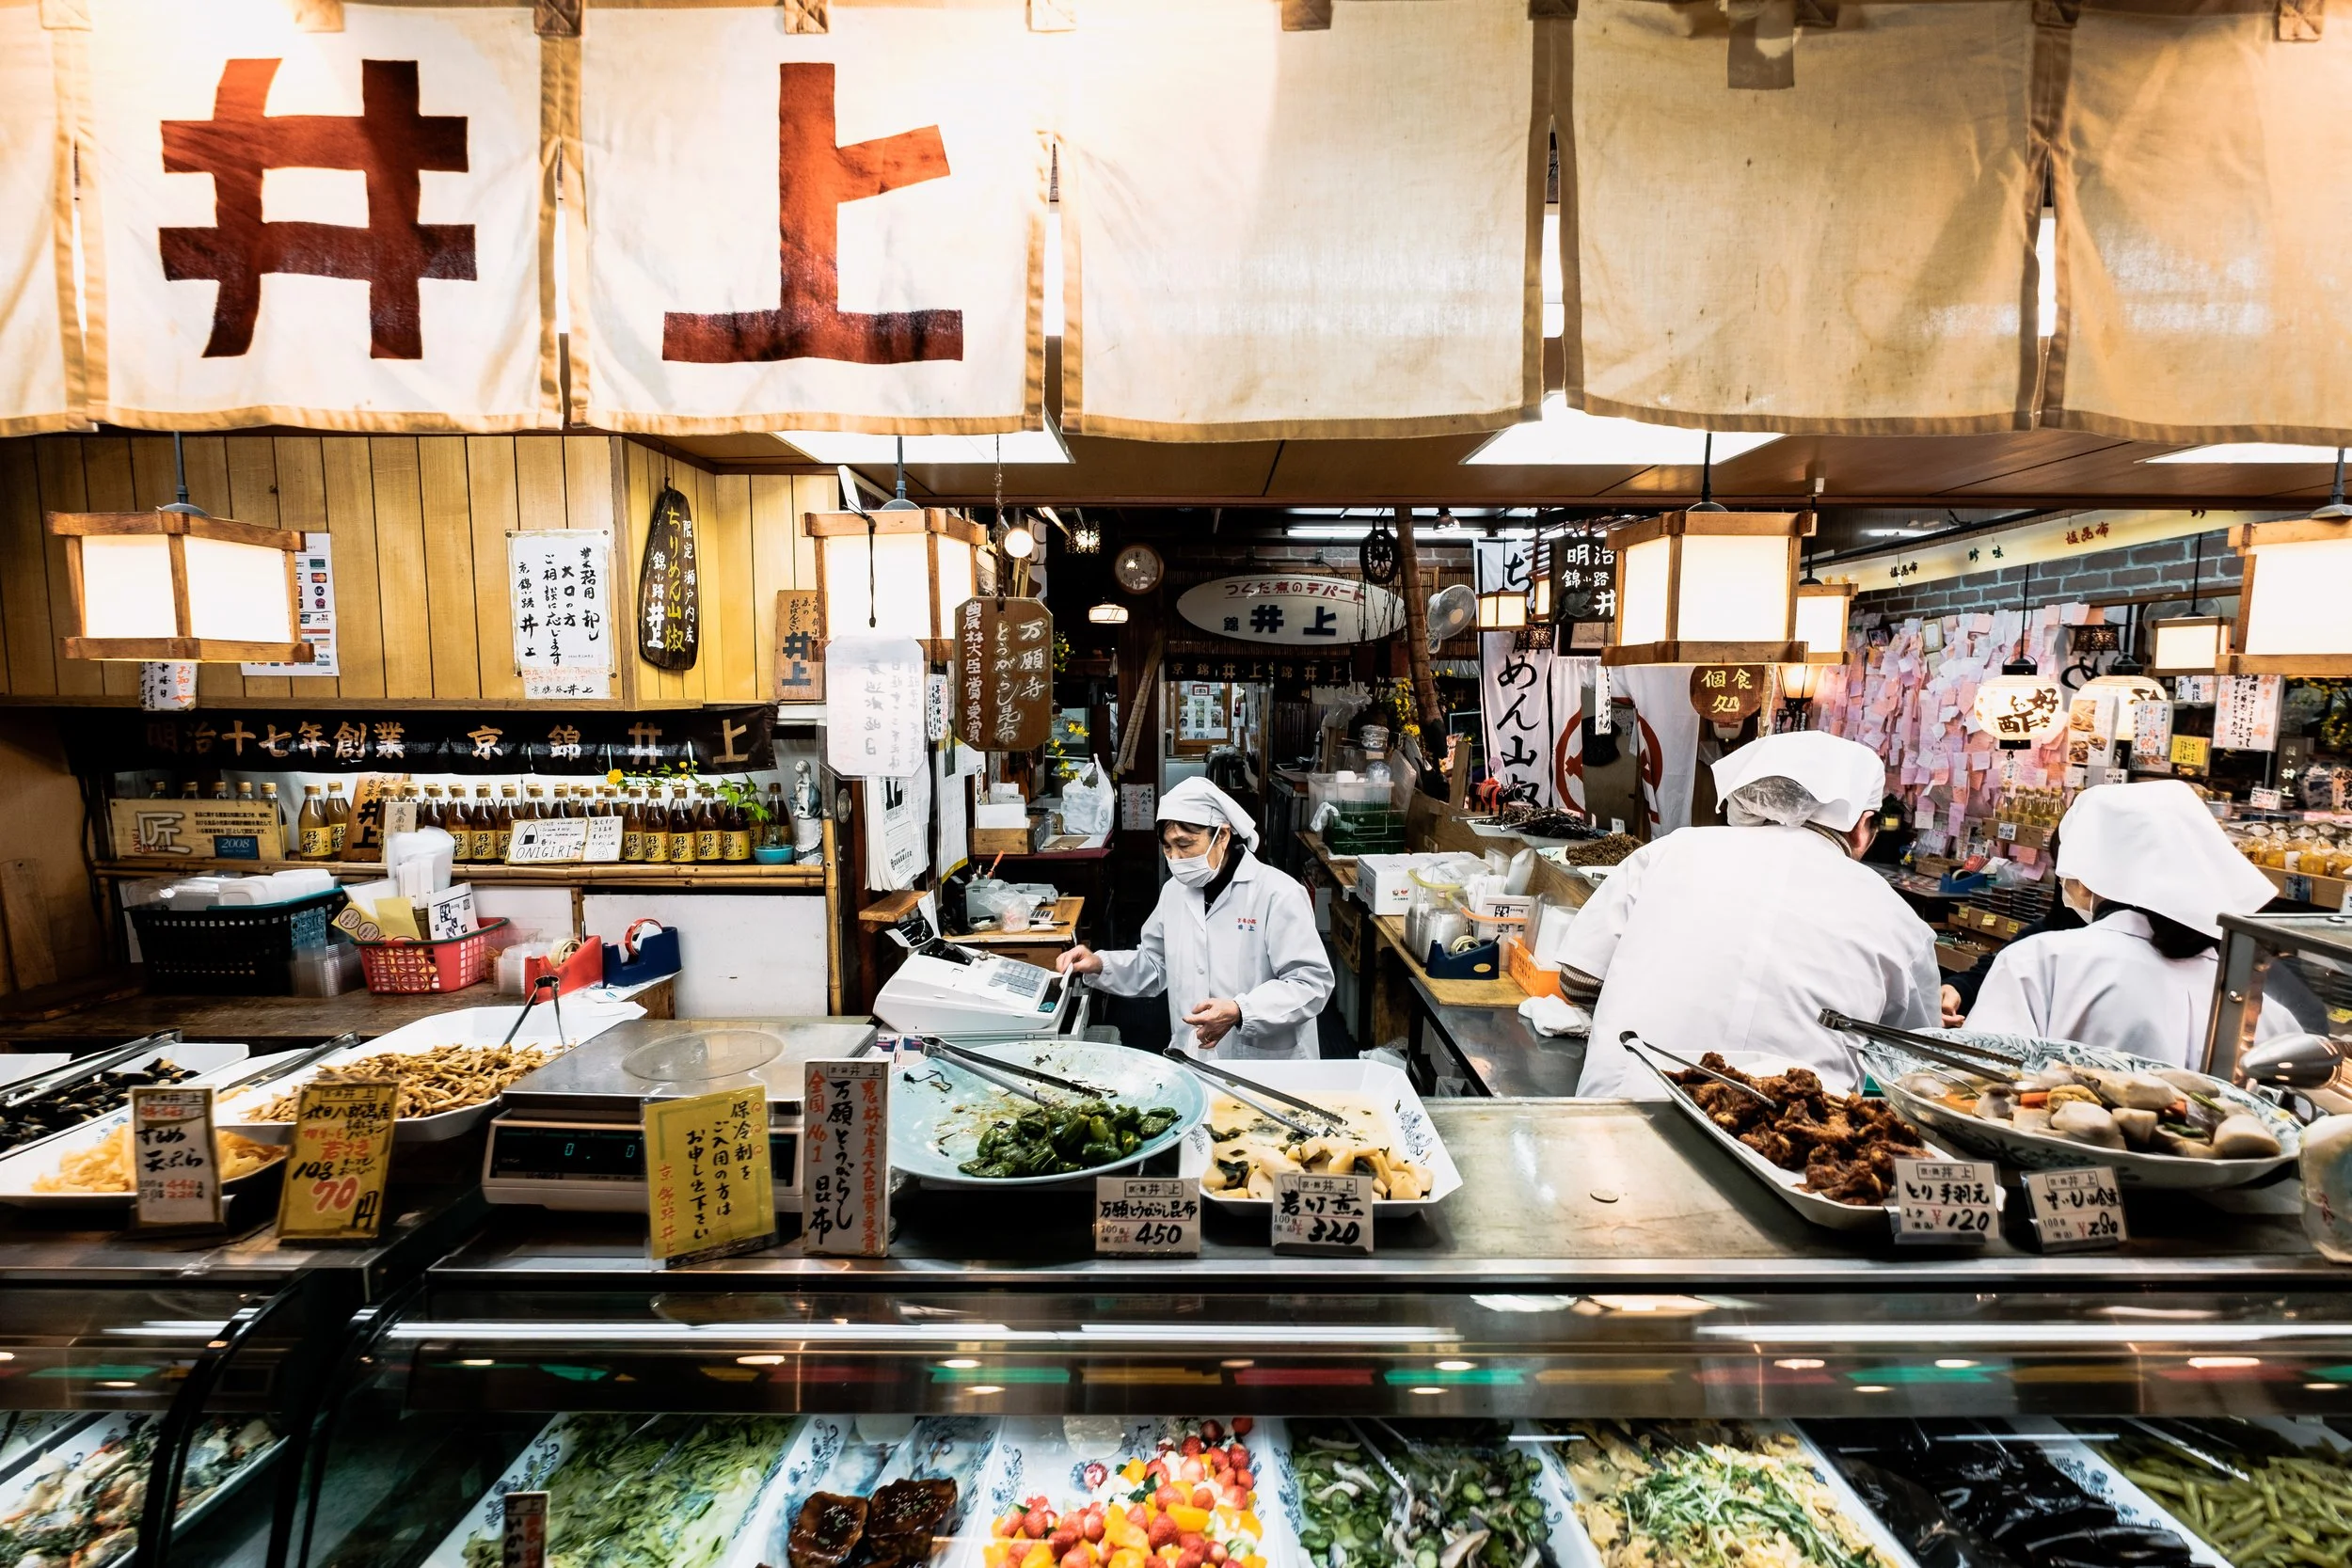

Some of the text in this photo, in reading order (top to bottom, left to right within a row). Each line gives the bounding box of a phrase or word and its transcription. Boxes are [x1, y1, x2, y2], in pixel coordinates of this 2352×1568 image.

[158, 58, 963, 363] 井上
[561, 565, 577, 627] 大口の方
[646, 551, 666, 649] 錦小路井上
[664, 506, 686, 653] ちりめん山椒
[682, 520, 696, 643] 限定 瀬戸内産
[1225, 581, 1366, 602] つくだ煮のデパート
[1561, 569, 1610, 589] 錦小路
[1224, 604, 1337, 637] 錦 井上
[782, 631, 812, 686] 井上
[995, 622, 1021, 743] とうがらし昆布
[1020, 620, 1045, 698] 万願寺
[147, 721, 406, 760] 明治十七年創業
[136, 812, 191, 855] 匠
[221, 838, 250, 848] 2008
[516, 845, 572, 860] ONIGIRI
[143, 1148, 204, 1173] 天ぷら
[729, 1100, 754, 1180] 保冷剤を
[826, 1080, 853, 1231] 万願とうがらし
[860, 1078, 883, 1256] 農林水産大臣賞受賞
[687, 1129, 708, 1240] お申し出下さい
[712, 1119, 732, 1216] ご入用の方は
[1904, 1180, 1990, 1205] とり 手羽元
[312, 1176, 379, 1230] 70 円
[1099, 1199, 1198, 1221] 万願とうがらし昆布
[1947, 1208, 1990, 1231] 120
[1135, 1222, 1183, 1245] 450
[1308, 1217, 1360, 1244] 320
